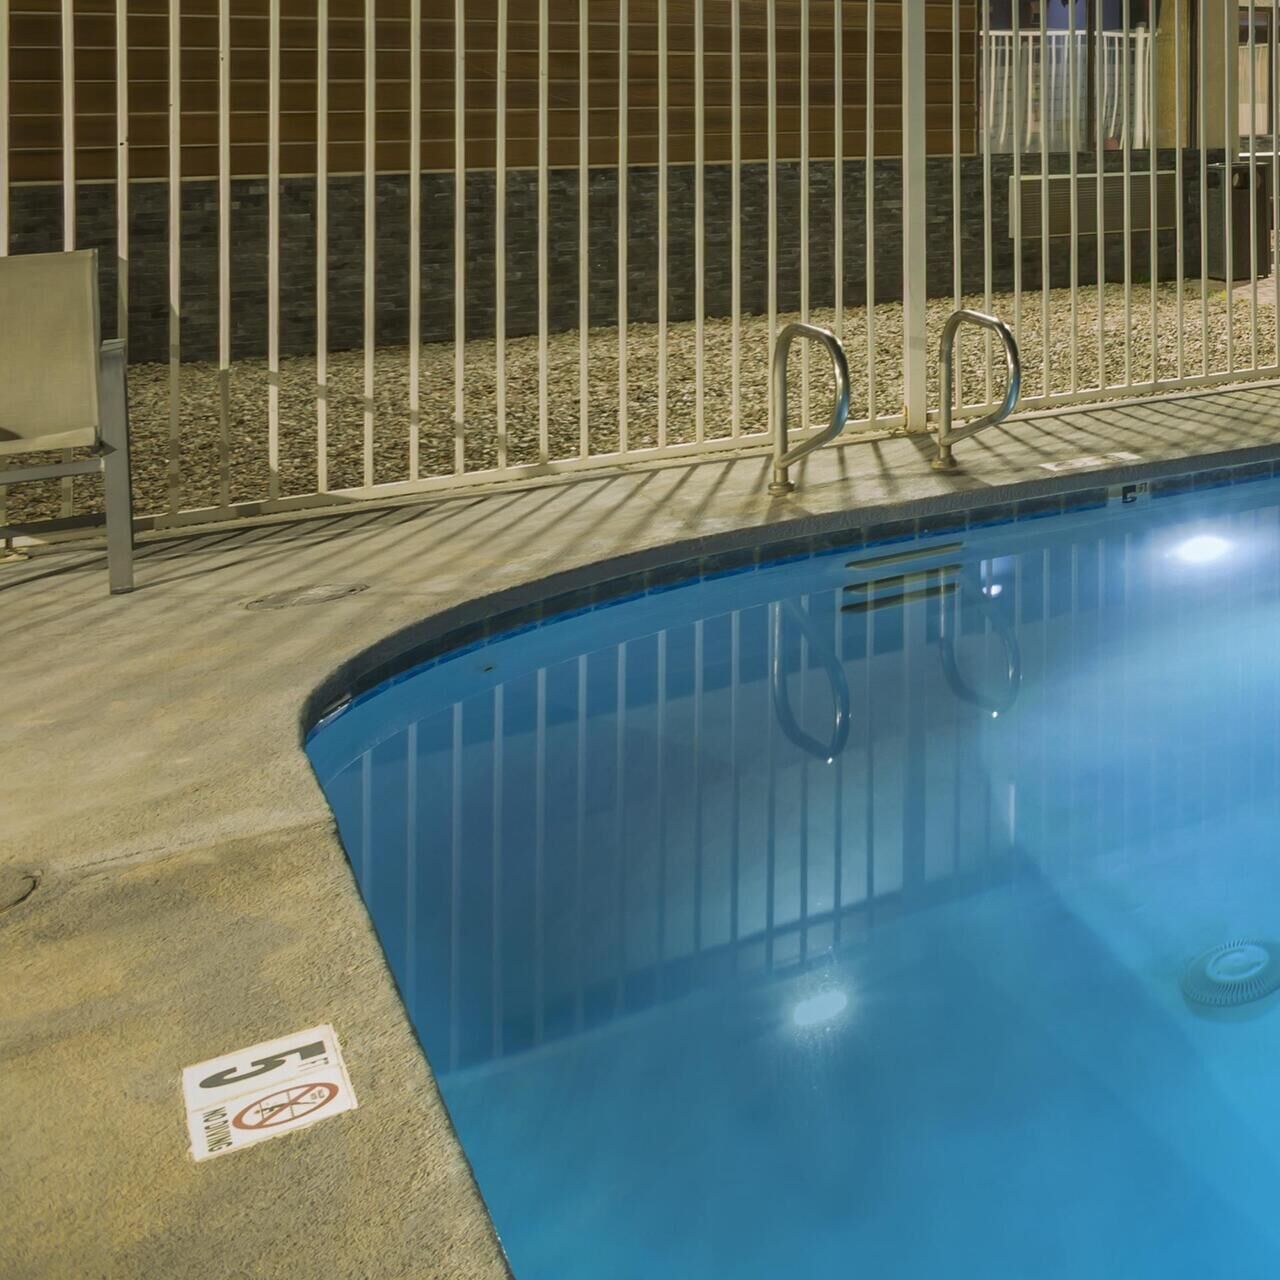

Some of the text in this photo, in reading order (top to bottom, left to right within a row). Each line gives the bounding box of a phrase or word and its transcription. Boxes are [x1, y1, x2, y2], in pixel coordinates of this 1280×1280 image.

[199, 1040, 326, 1089] 5
[202, 1106, 233, 1153] NO DIVING
